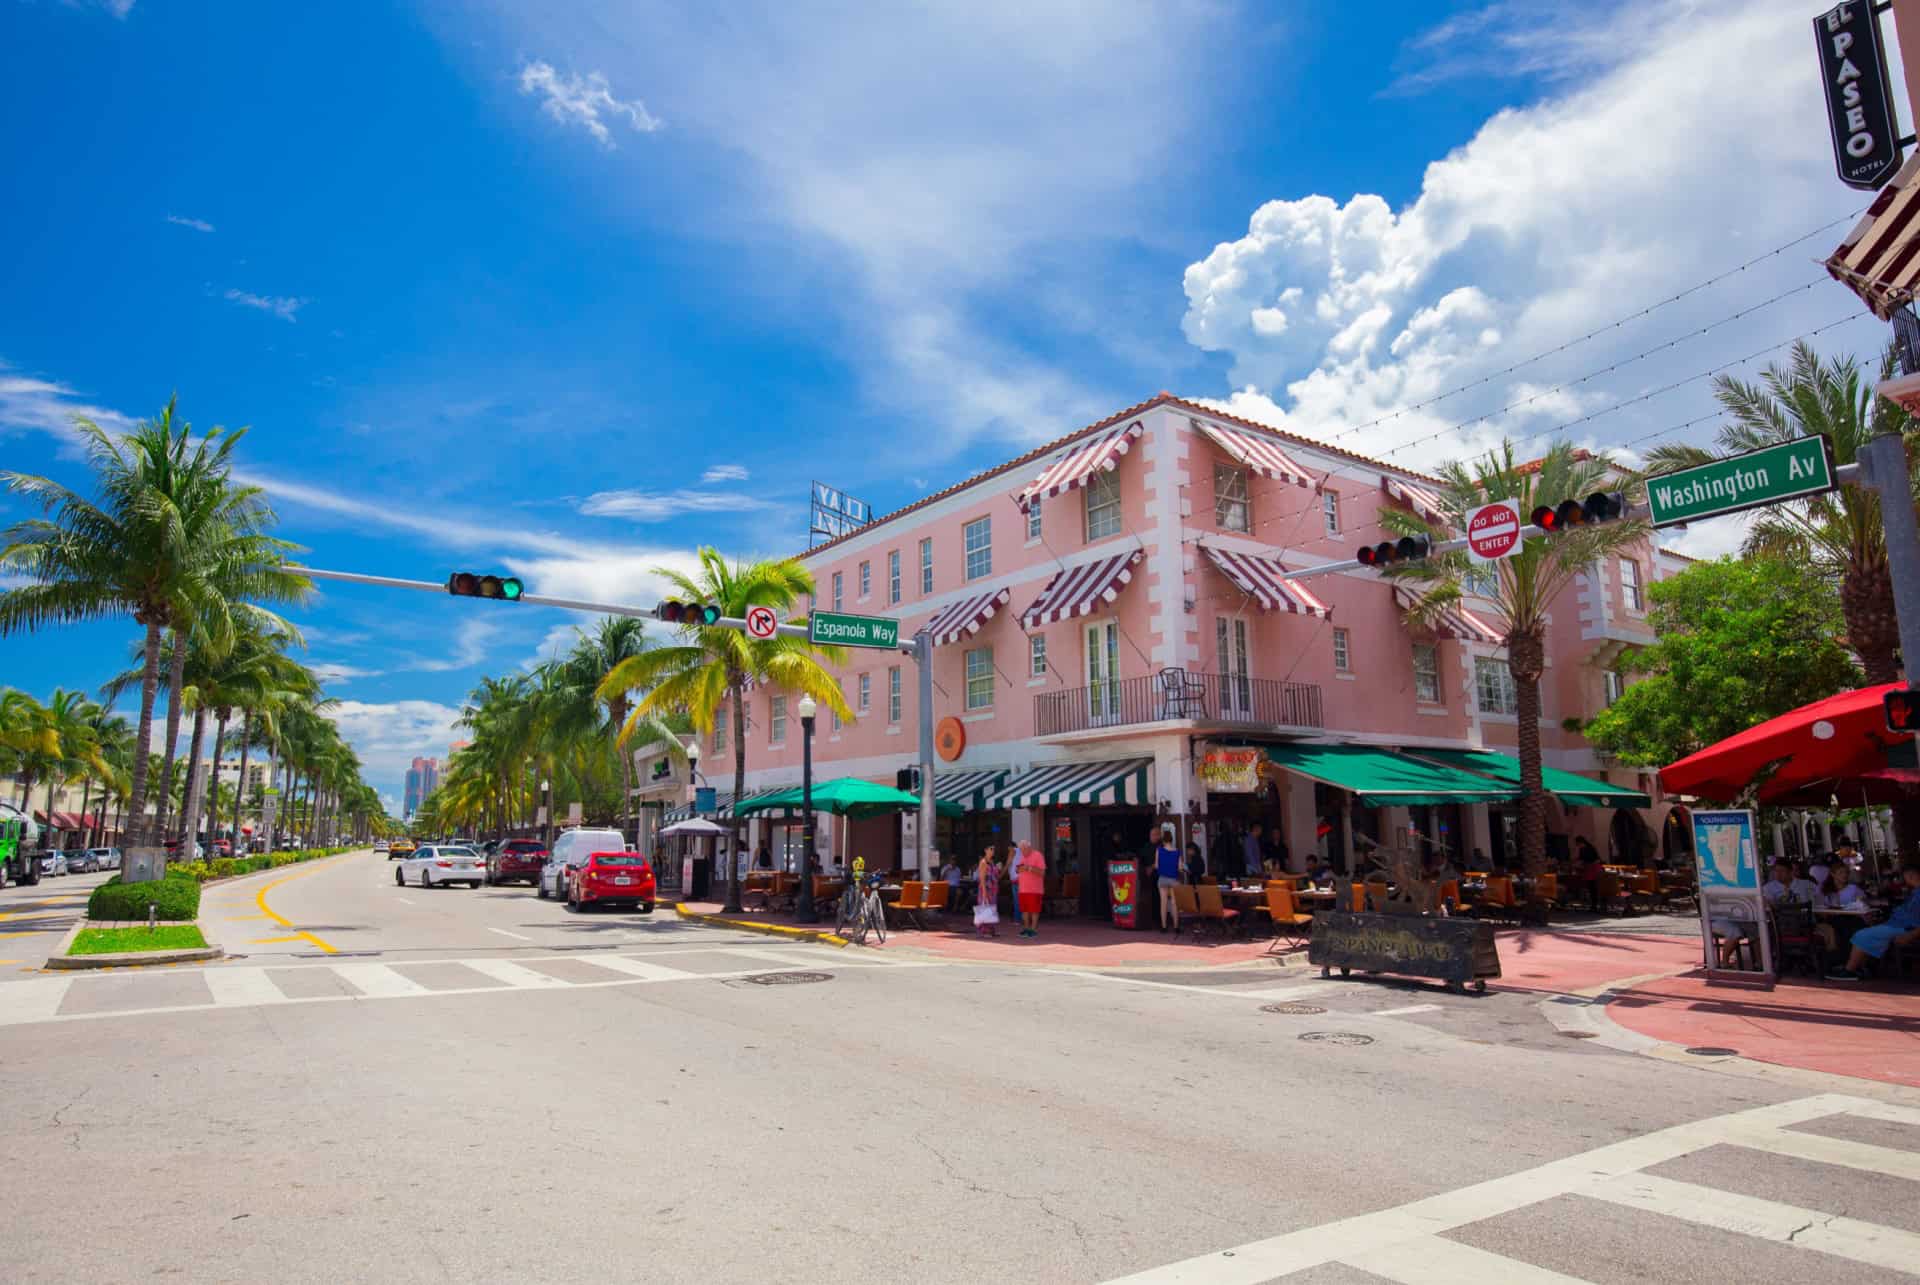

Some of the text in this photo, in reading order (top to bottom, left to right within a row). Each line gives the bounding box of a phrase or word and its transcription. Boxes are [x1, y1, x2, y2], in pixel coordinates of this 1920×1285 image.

[1827, 6, 1853, 32] EL
[1832, 32, 1874, 158] PASEO
[1852, 159, 1884, 176] HOTEL
[1656, 455, 1815, 511] Washington Av
[1474, 511, 1510, 528] DO NOT
[1480, 536, 1509, 551] ENTER
[815, 619, 896, 644] Espanola Way
